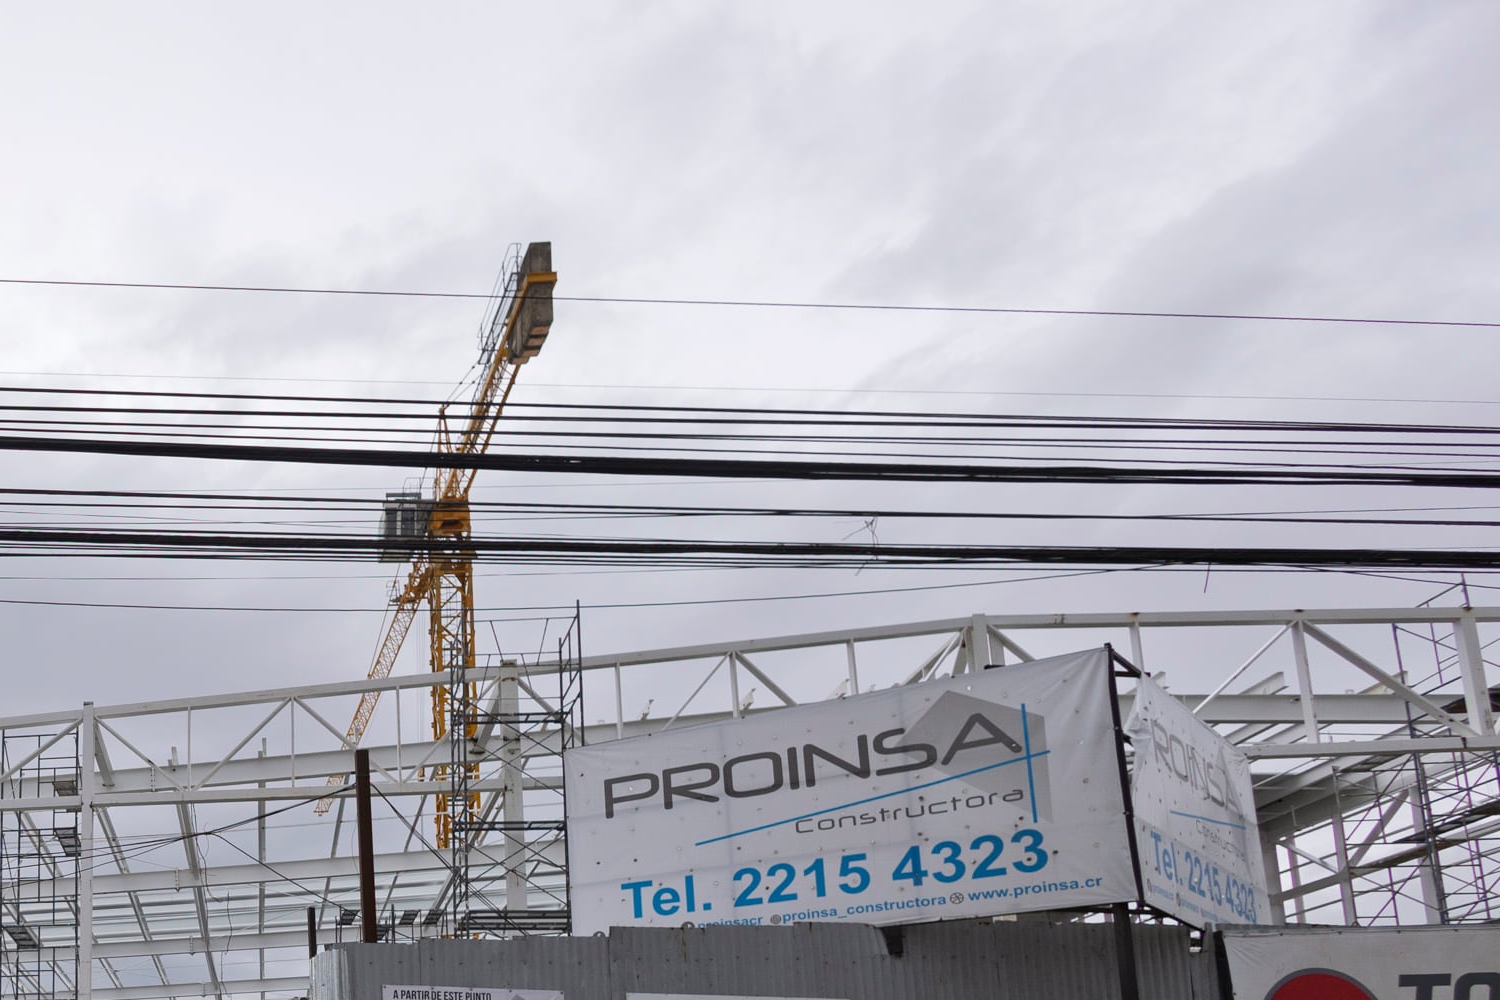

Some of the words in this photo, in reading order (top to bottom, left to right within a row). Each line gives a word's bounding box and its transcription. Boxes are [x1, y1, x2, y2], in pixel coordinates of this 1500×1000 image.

[604, 712, 1022, 818] PROINSA
[1151, 719, 1243, 819] ROINSA
[795, 789, 1024, 834] Constructora
[621, 875, 711, 919] Tel.
[732, 852, 871, 908] 2215
[892, 829, 1048, 887] 4323
[967, 877, 1102, 901] www.proinsa.cr
[1151, 831, 1183, 886] Tel.
[1185, 851, 1222, 907] 2215
[1225, 874, 1256, 924] 4323
[393, 990, 399, 999] A
[401, 990, 429, 1000] PARTIR
[431, 991, 442, 1000] DE
[444, 992, 463, 1000] ESTE
